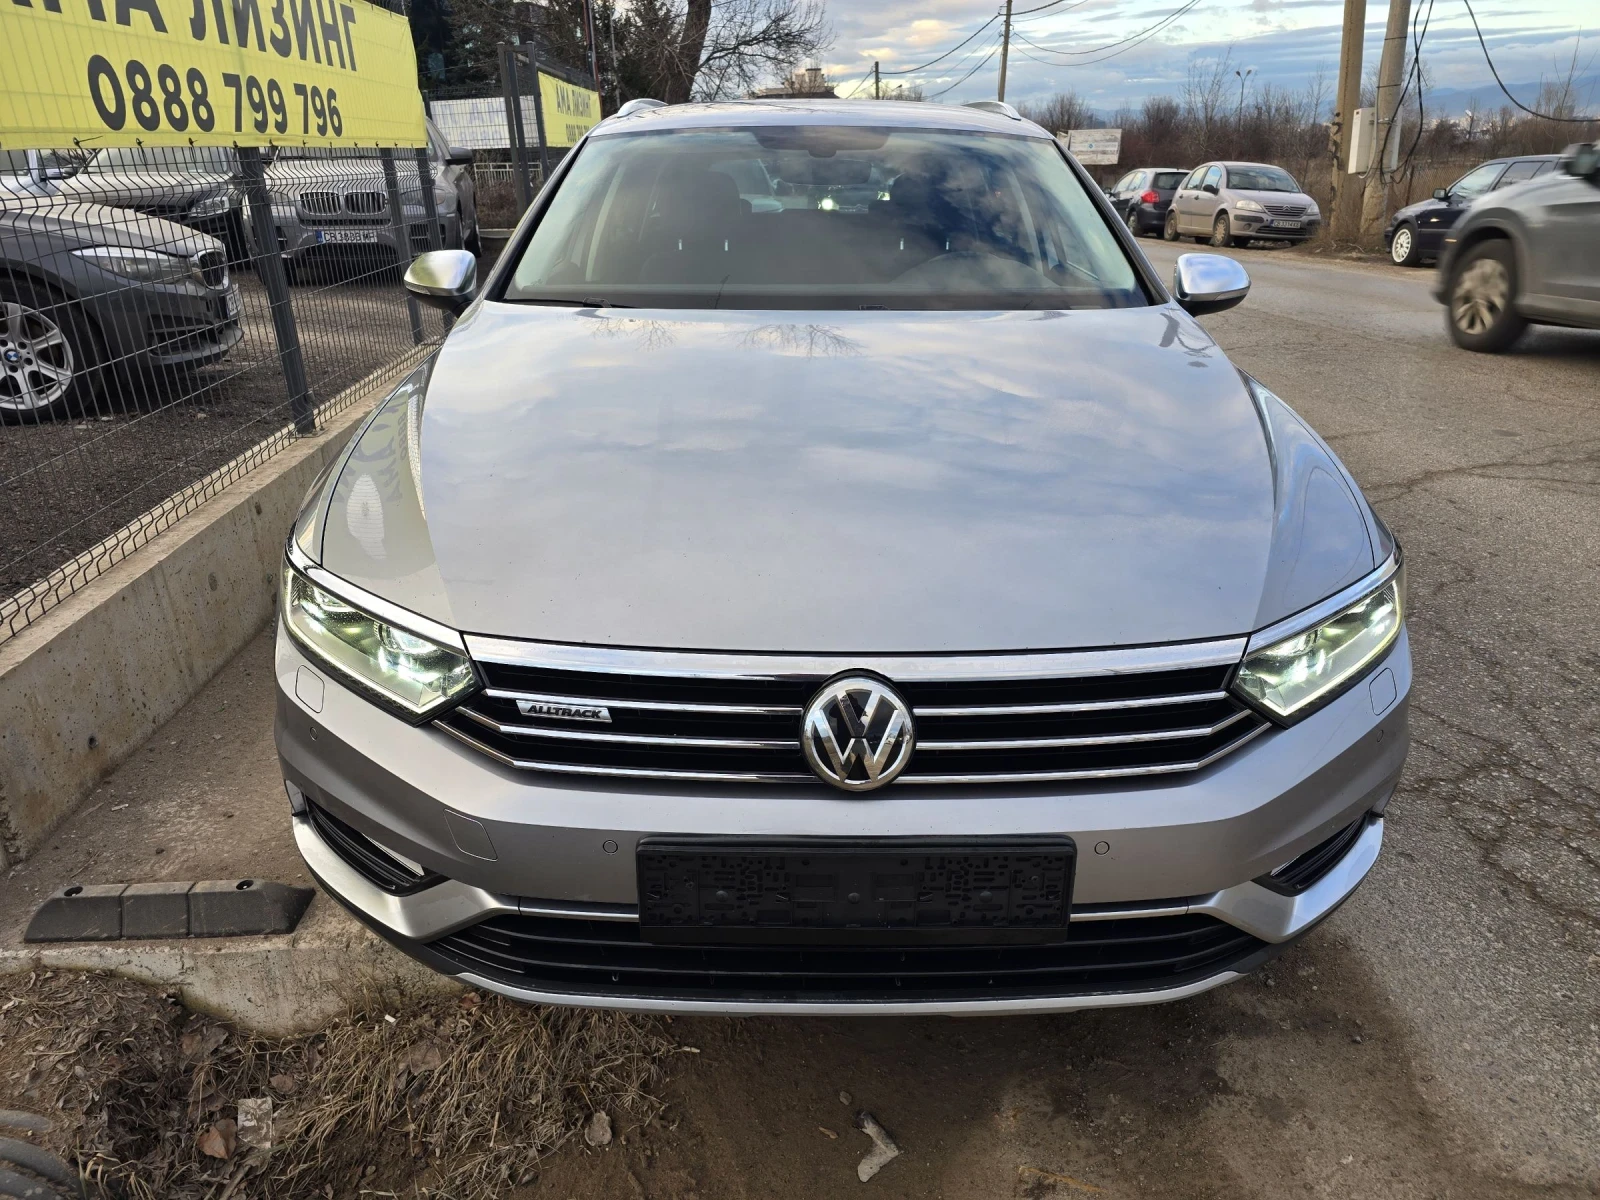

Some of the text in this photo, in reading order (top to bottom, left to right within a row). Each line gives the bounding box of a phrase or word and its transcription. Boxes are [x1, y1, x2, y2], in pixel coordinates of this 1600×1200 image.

[87, 54, 343, 137] 0888 799 796
[527, 704, 602, 719] ALLTRACK
